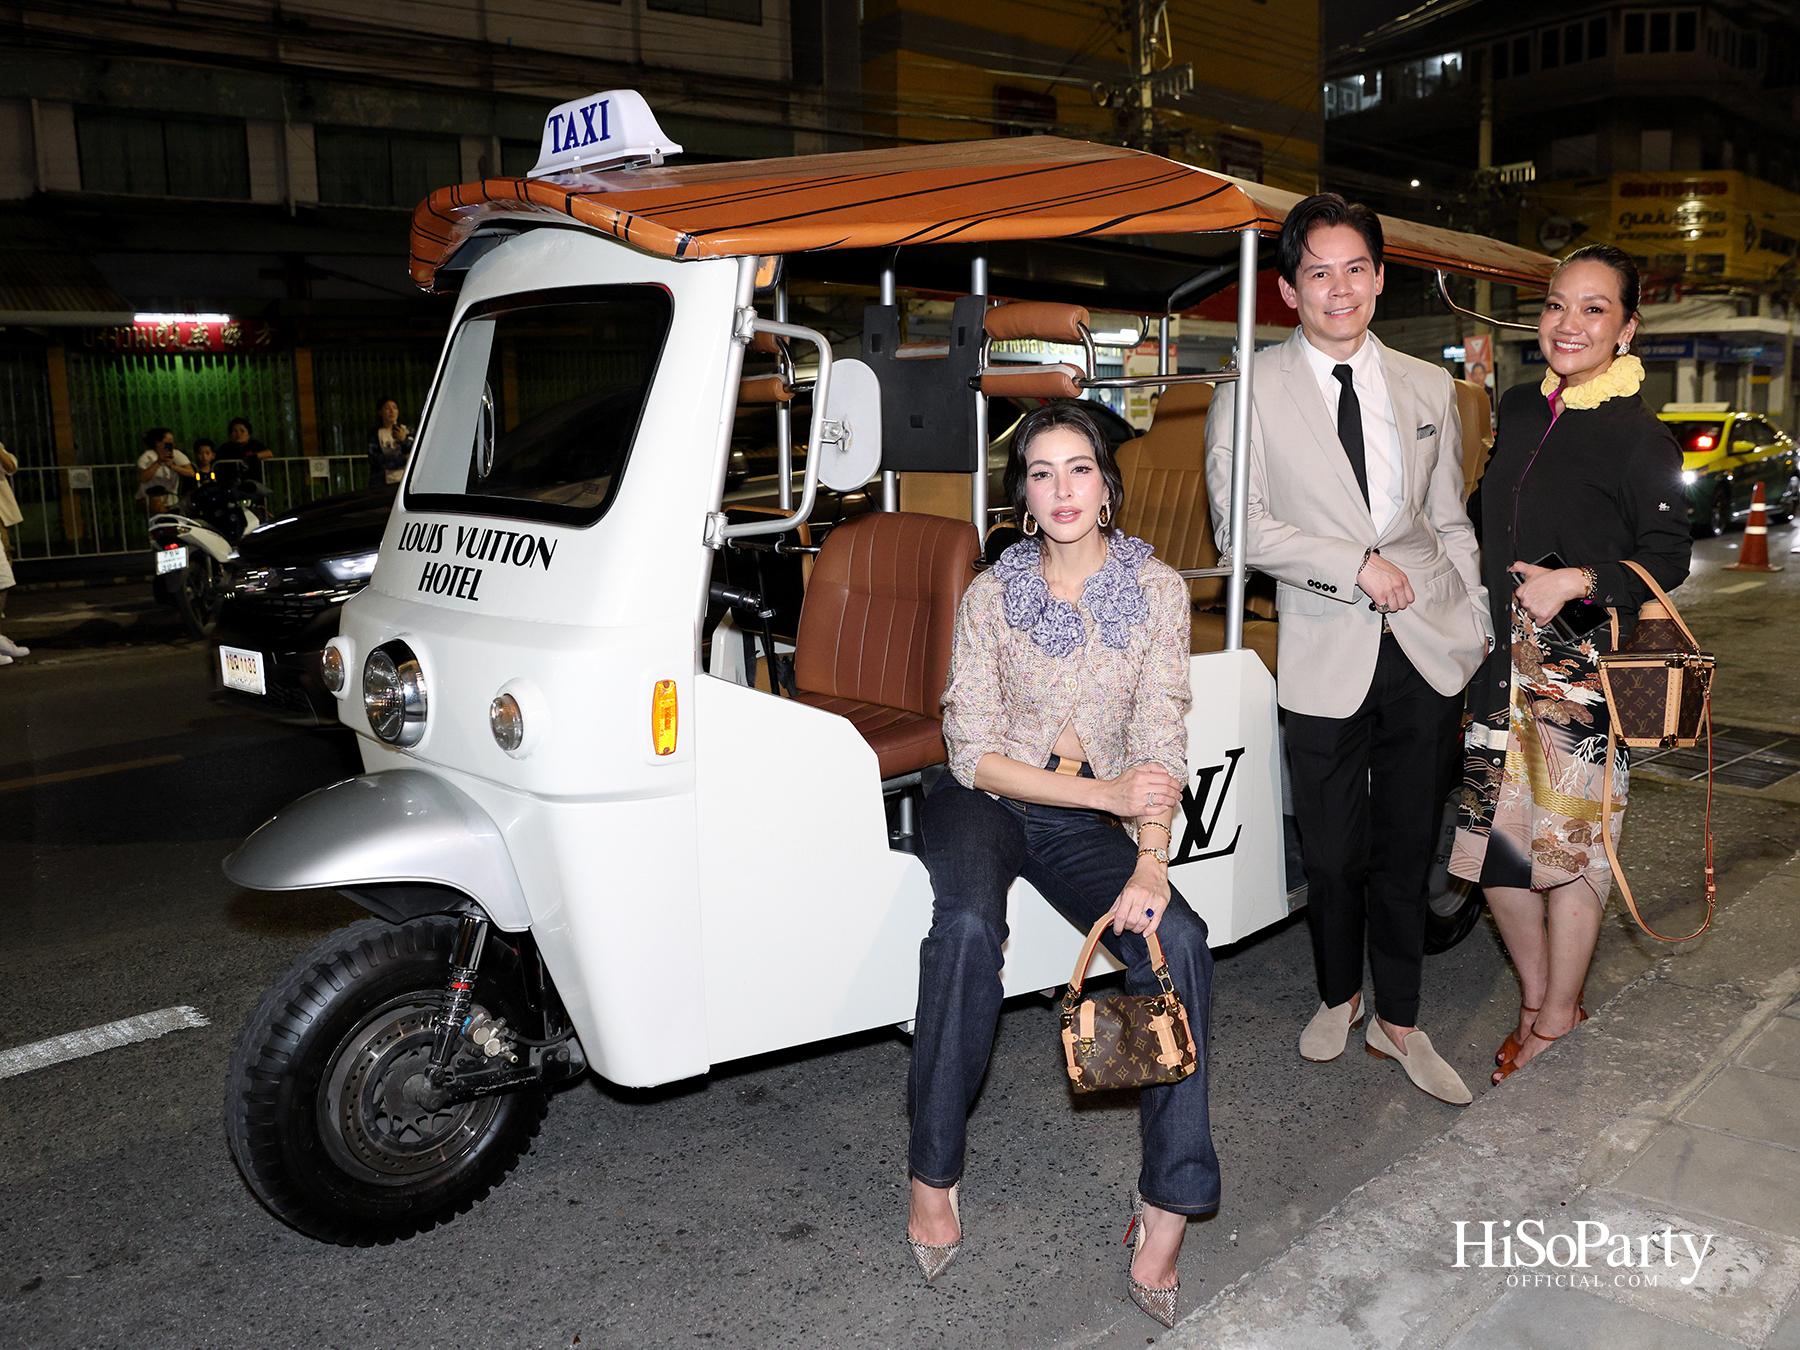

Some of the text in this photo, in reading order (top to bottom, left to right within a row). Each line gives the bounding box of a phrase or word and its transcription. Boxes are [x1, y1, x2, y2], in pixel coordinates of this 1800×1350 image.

[548, 99, 611, 154] TAXI
[398, 522, 558, 571] LOUIS VUITTON
[417, 561, 483, 602] HOTEL
[1168, 747, 1245, 867] LV
